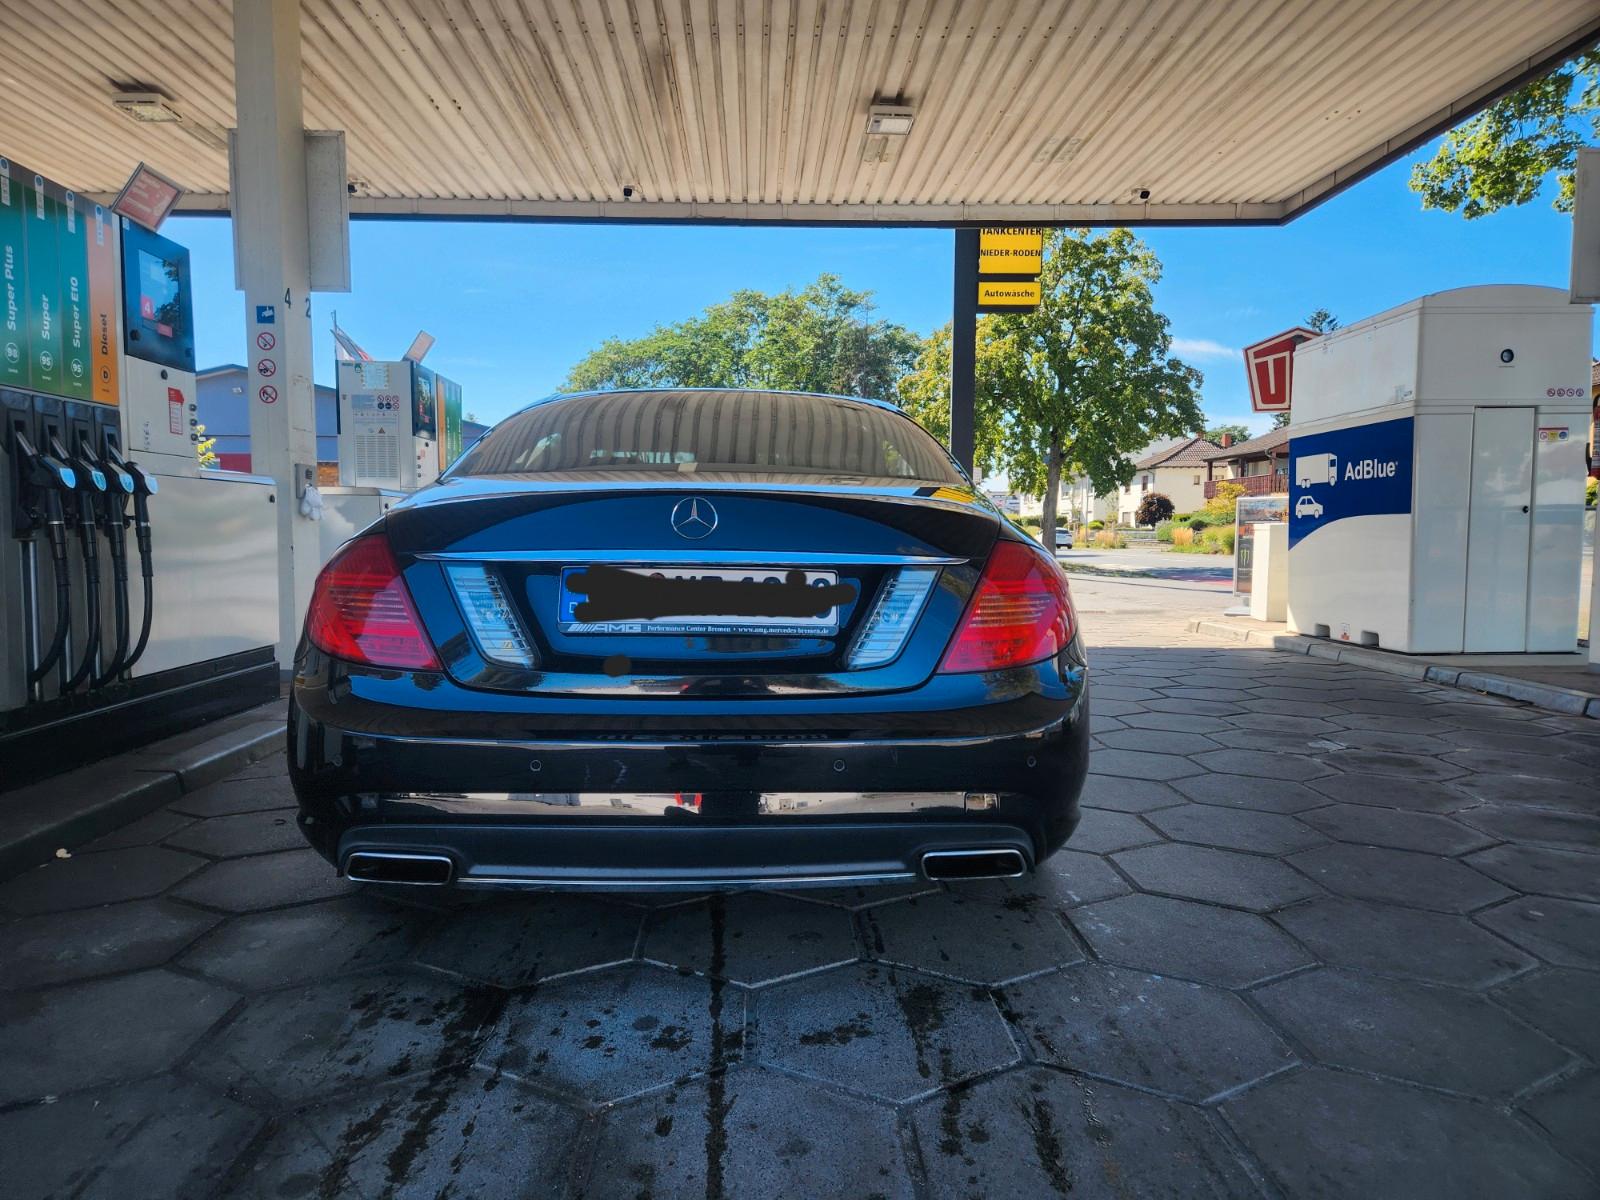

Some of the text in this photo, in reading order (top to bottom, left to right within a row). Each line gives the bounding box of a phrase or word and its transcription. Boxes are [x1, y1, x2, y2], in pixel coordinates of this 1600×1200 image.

[980, 249, 1041, 257] NIEDER-RODEN
[4, 245, 18, 331] Super Plus
[284, 287, 291, 310] 4
[305, 297, 311, 318] 2
[42, 294, 52, 340] Super
[70, 276, 81, 348] Super E10
[100, 312, 109, 356] Diesel
